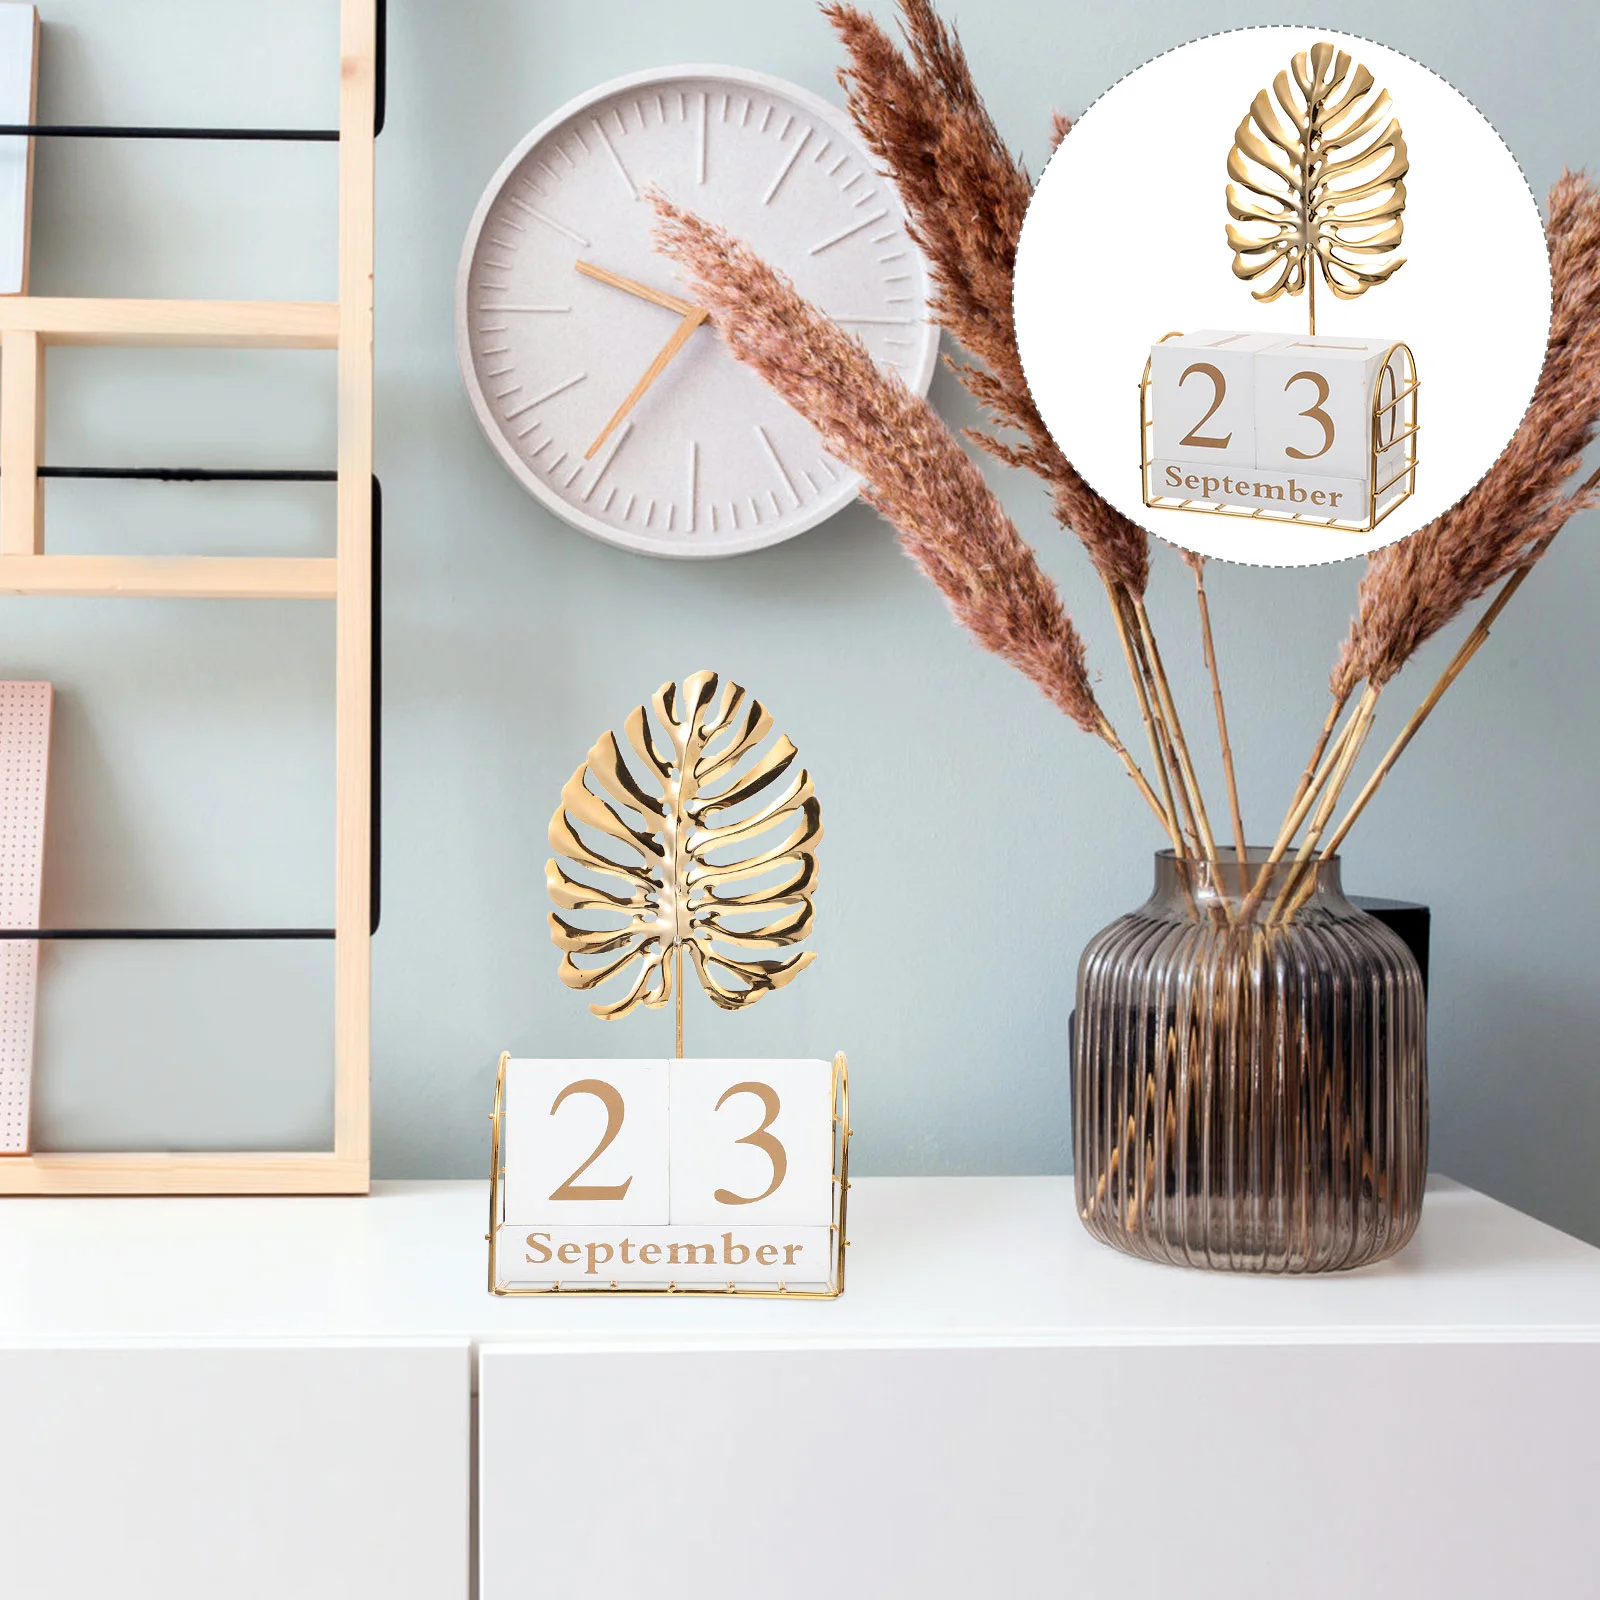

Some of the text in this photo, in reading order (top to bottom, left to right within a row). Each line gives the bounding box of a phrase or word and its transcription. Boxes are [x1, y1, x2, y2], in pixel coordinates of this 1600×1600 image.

[1177, 361, 1336, 460] 2 3
[1165, 464, 1344, 508] September
[548, 1077, 788, 1206] 2 3
[524, 1231, 804, 1275] September
